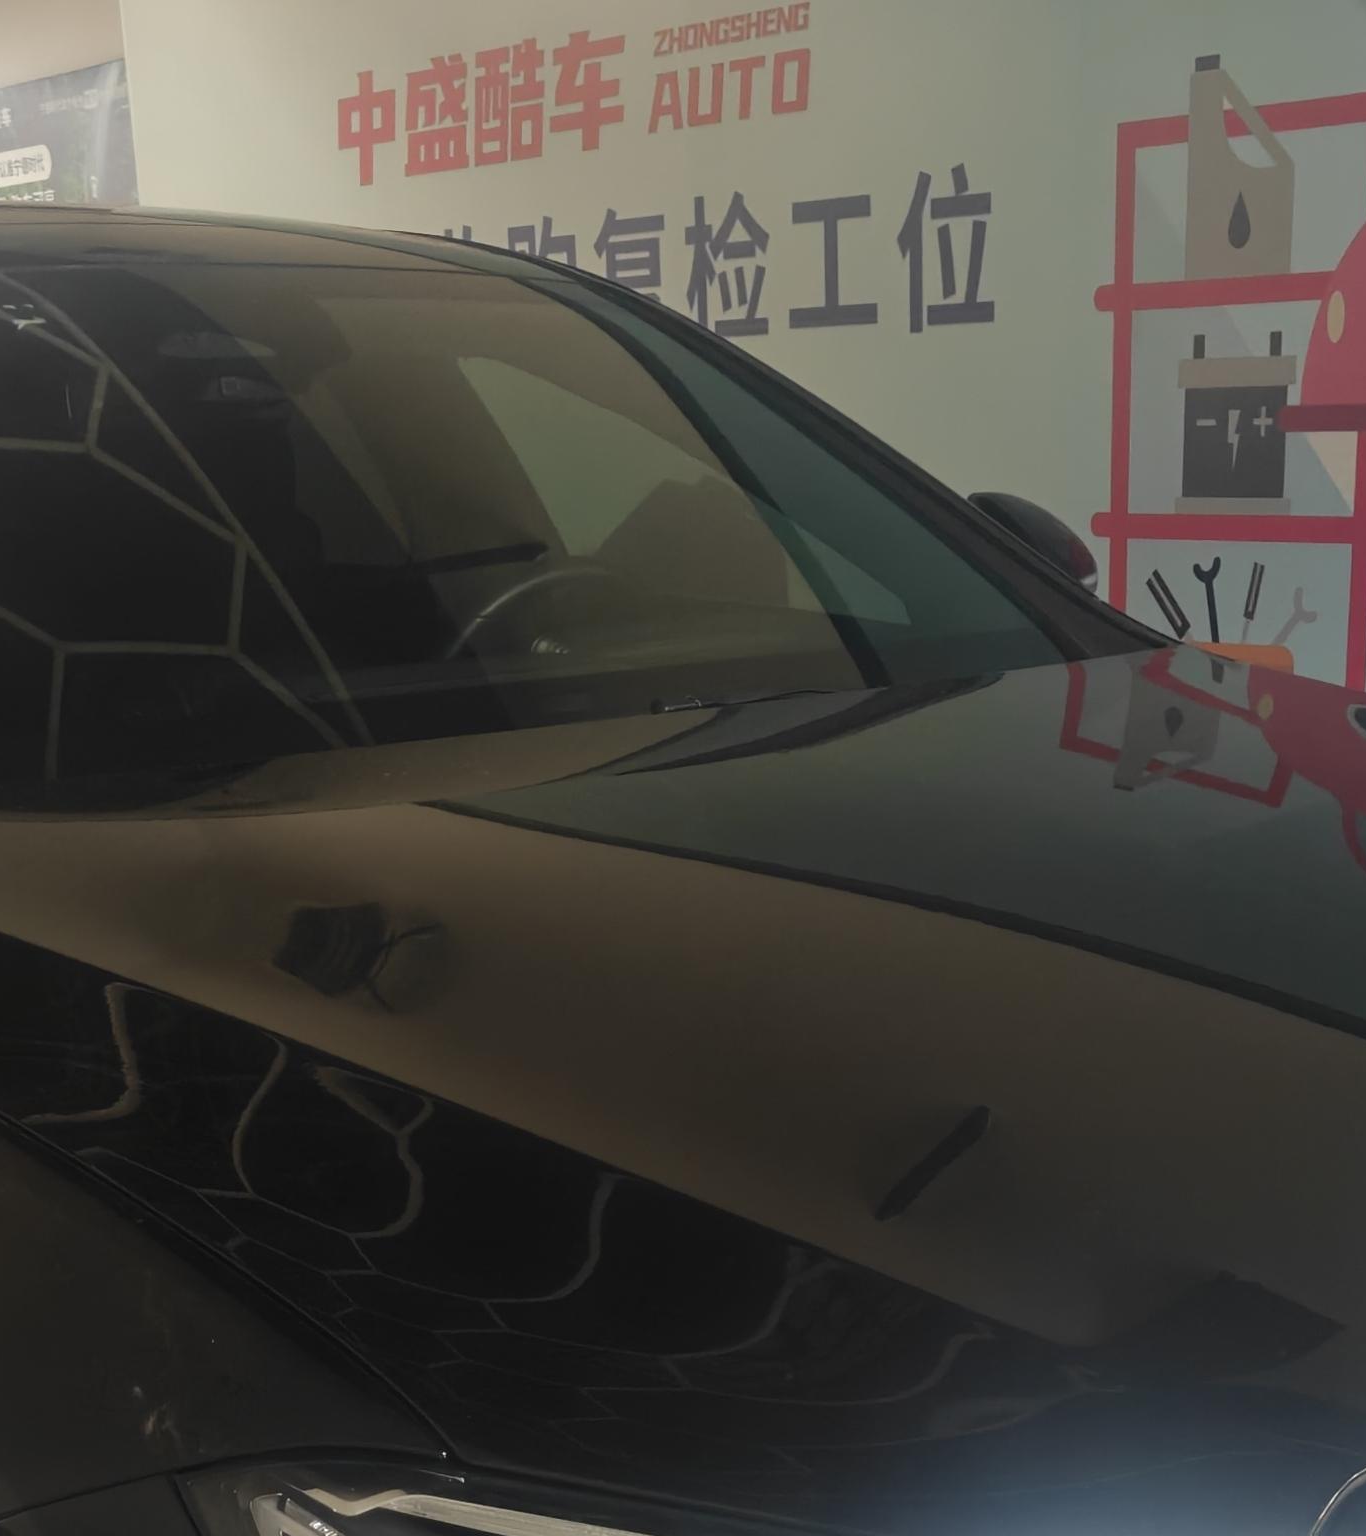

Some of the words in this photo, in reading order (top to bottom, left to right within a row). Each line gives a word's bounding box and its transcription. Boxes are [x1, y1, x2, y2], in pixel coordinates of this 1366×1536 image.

[653, 2, 811, 57] ZHONGSHENG
[337, 30, 626, 186] 中盛酷车
[648, 48, 812, 134] AUTO
